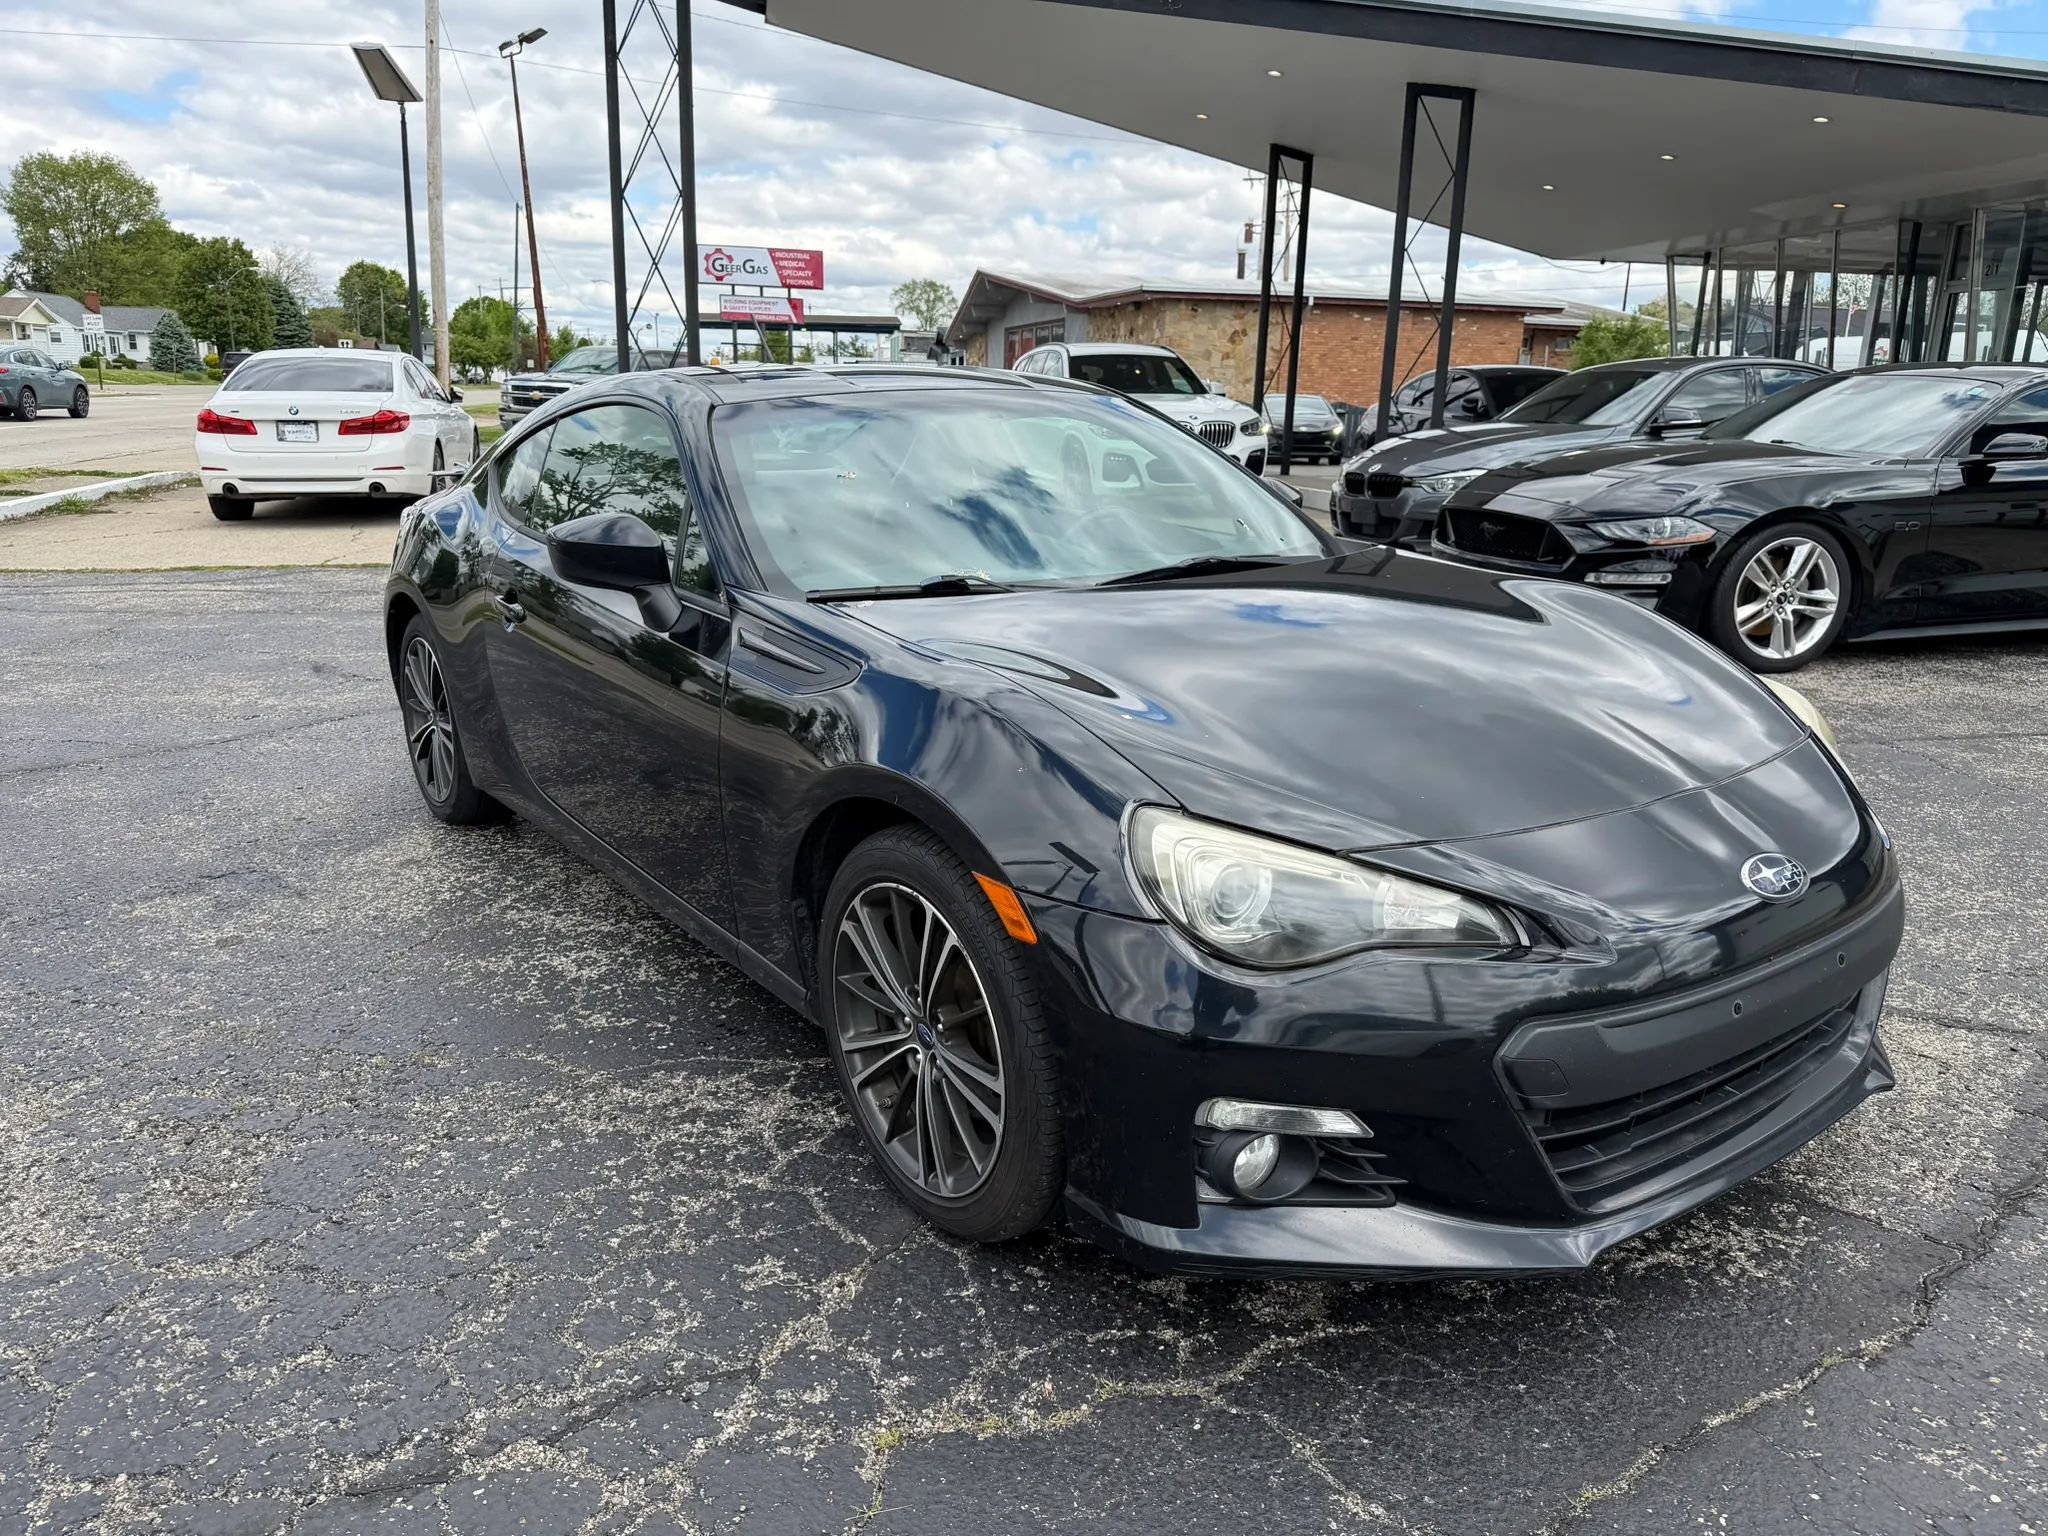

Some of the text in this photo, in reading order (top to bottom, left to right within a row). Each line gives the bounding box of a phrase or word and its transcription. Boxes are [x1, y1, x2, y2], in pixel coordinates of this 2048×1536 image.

[775, 251, 810, 260] INDUSTRIAL
[779, 260, 806, 268] MEDICAL
[782, 269, 812, 277] SPECIALTY
[786, 278, 814, 286] PROPANE
